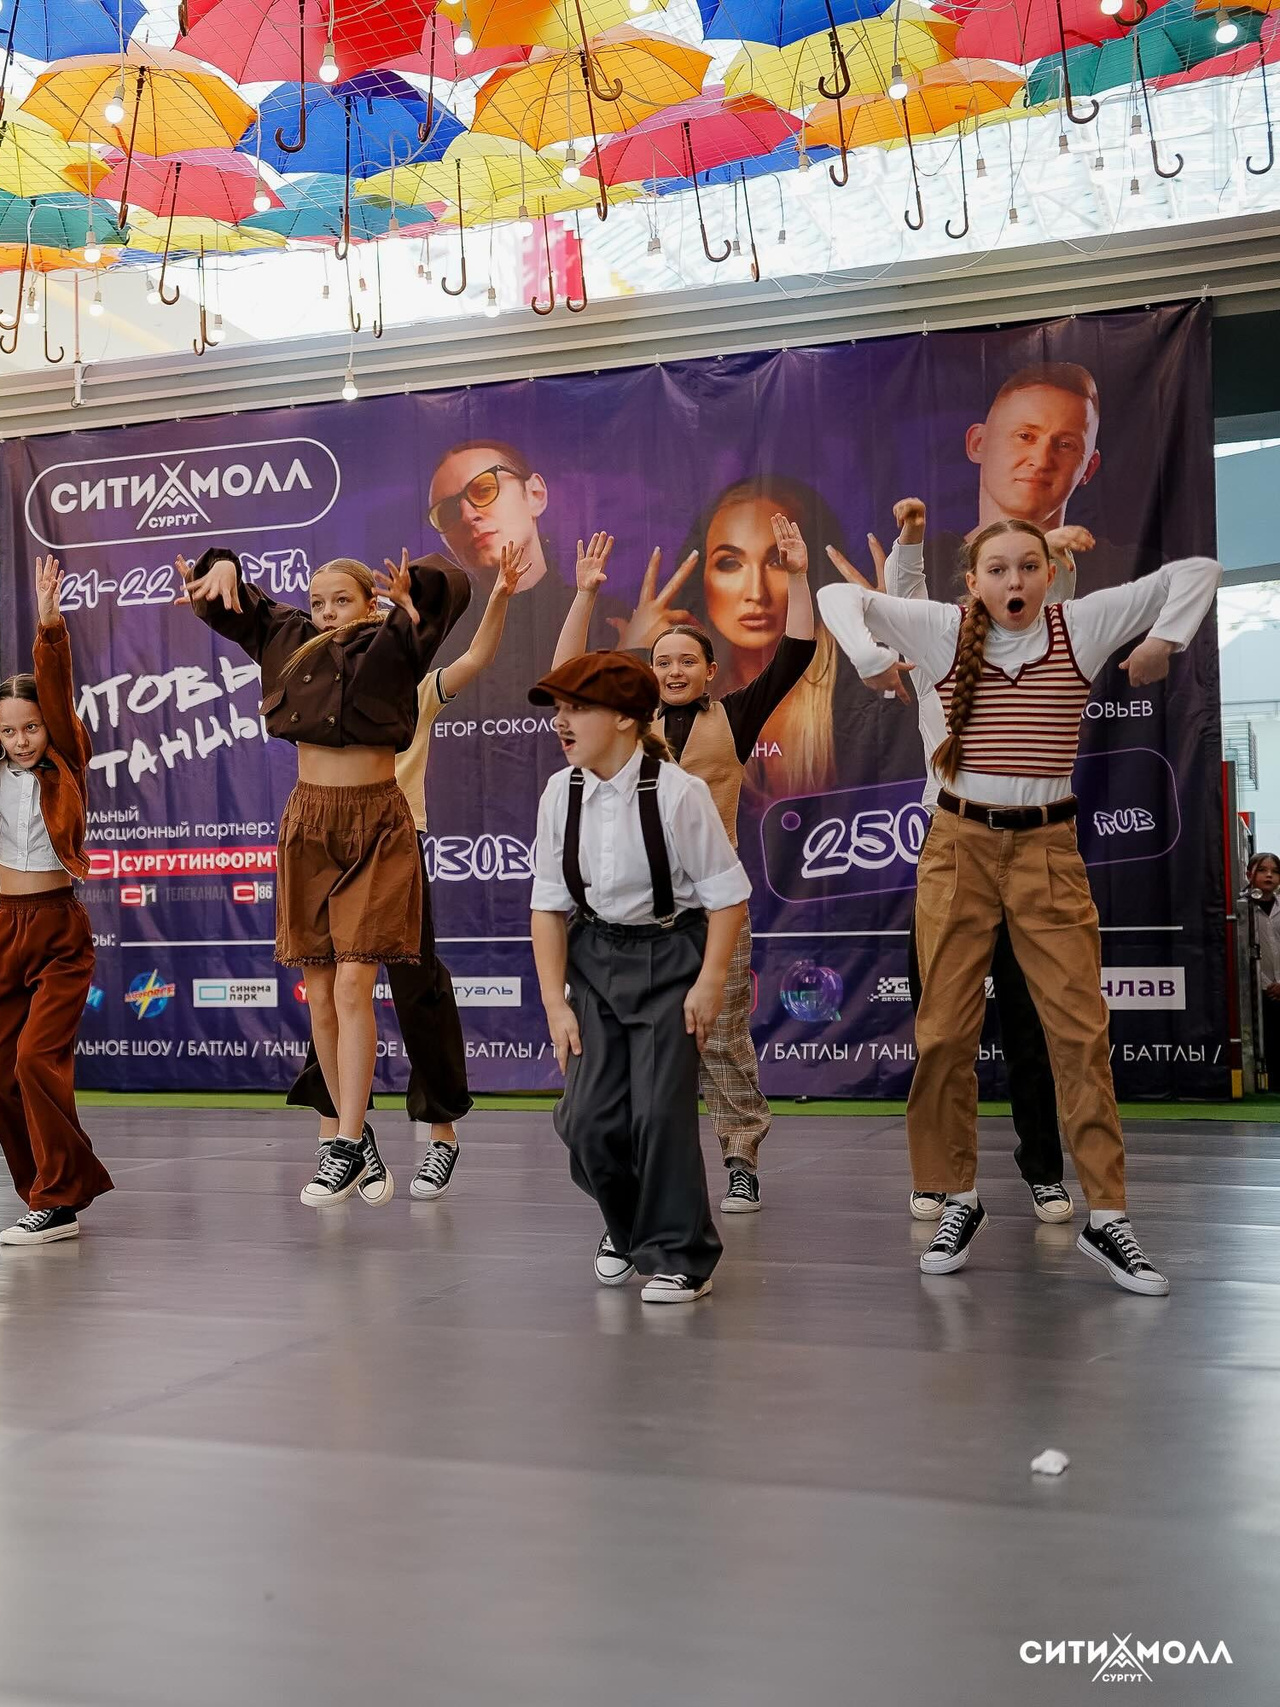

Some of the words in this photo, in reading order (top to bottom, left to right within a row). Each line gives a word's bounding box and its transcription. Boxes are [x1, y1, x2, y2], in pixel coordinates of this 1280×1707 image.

[148, 513, 198, 528] СУРГУТ
[59, 565, 175, 612] 21-22
[1081, 700, 1153, 719] ОВЬЕВ
[434, 721, 477, 738] ЕГОР
[89, 701, 269, 788] ТАНЦЫ
[84, 821, 190, 842] мационный
[195, 821, 275, 841] партнер:
[1094, 808, 1155, 836] RUB
[453, 986, 513, 998] туаль
[1101, 980, 1176, 997] нлав
[230, 994, 258, 1003] парк
[74, 1040, 129, 1056] ЛЬНОЕ
[132, 1040, 172, 1056] ШОУ
[188, 1041, 247, 1057] БАТТЛЫ
[263, 1041, 310, 1058] ТАНЦ
[465, 1042, 533, 1059] БАТТЛЫ
[775, 1043, 848, 1060] БАТТЛЫ
[1124, 1044, 1205, 1061] БАТТЛЫ
